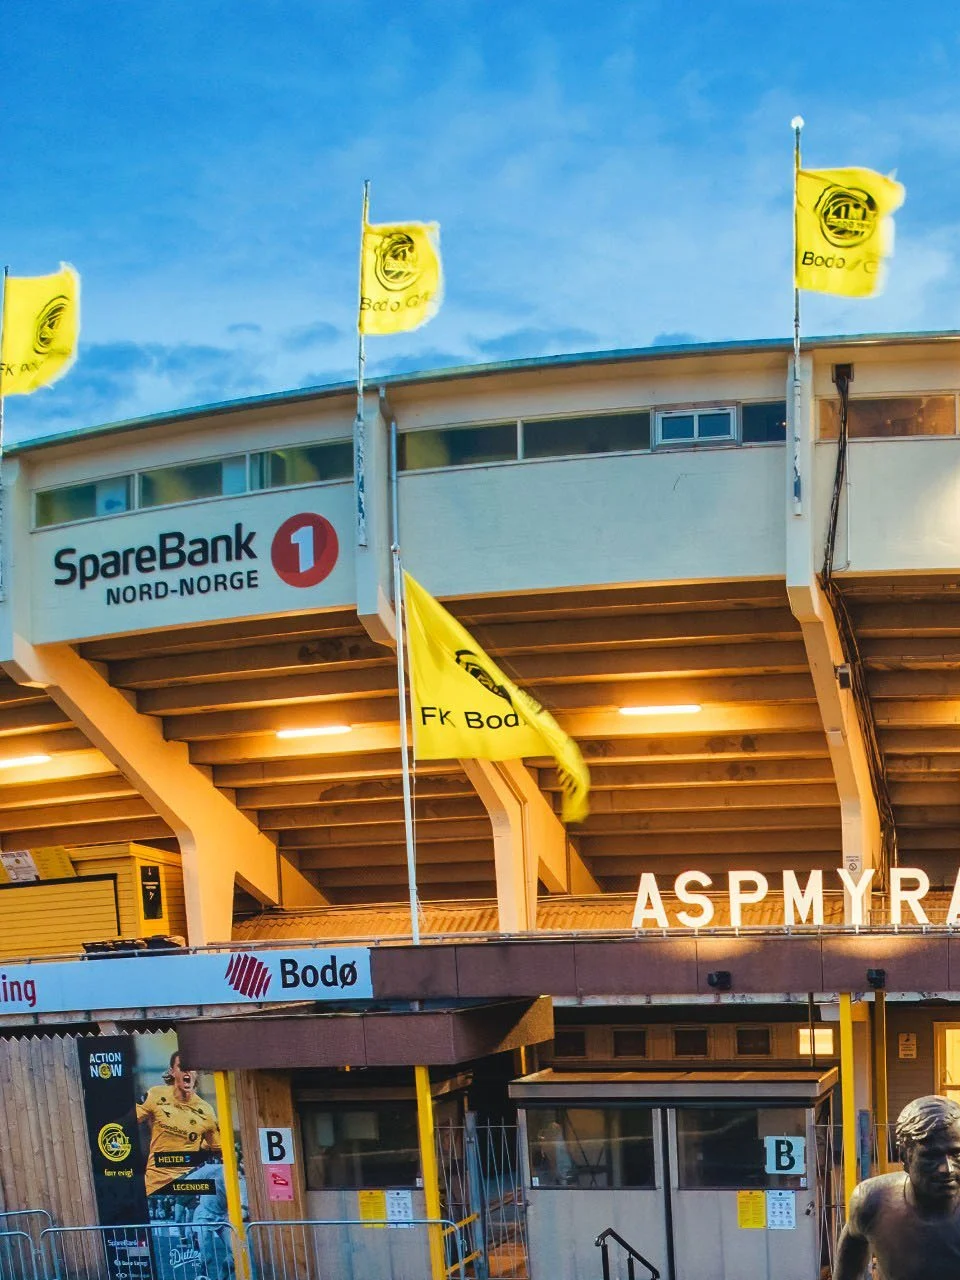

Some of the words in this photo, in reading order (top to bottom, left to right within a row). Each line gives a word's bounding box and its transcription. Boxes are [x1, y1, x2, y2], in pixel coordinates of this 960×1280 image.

[54, 522, 258, 590] SpareBank
[290, 525, 316, 574] 1
[106, 569, 259, 606] NORD-NORGE
[421, 706, 456, 728] FK
[464, 711, 528, 729] Bod
[280, 954, 358, 989] Bodø
[0, 974, 36, 1007] ing
[89, 1052, 122, 1063] ACTION
[90, 1064, 122, 1079] NOW
[158, 1155, 184, 1163] HELTER
[266, 1131, 286, 1162] B
[775, 1139, 796, 1171] B
[172, 1183, 210, 1191] LEGENDER
